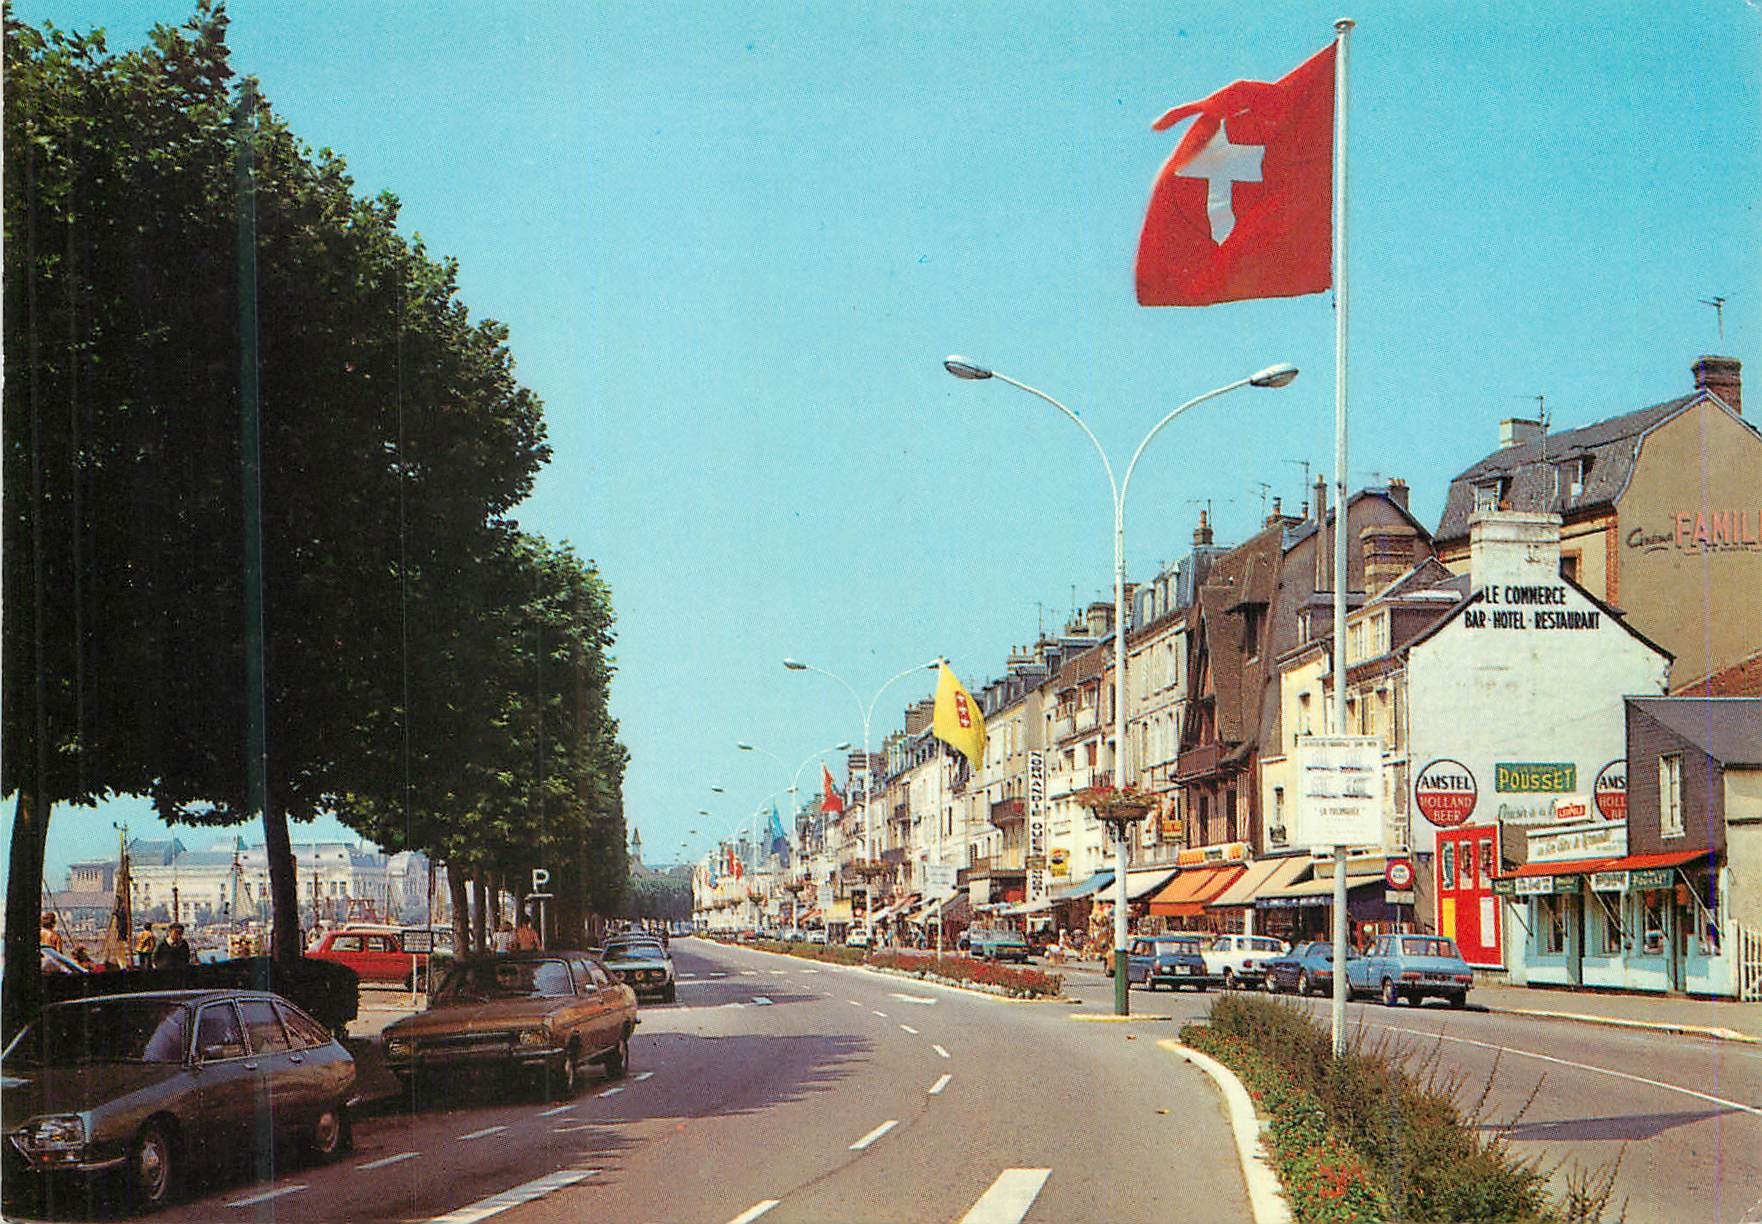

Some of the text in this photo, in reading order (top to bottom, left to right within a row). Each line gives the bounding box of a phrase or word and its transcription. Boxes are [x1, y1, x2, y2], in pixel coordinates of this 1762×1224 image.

[1675, 511, 1762, 548] FAMIL
[1485, 586, 1566, 604] LE COMMERCE
[1465, 610, 1600, 629] BAR HOTEL RESTAURANT
[1420, 775, 1471, 790] AMSTEL
[1419, 796, 1472, 808] HOLLAND
[1433, 809, 1461, 821] BEER
[532, 868, 551, 894] P
